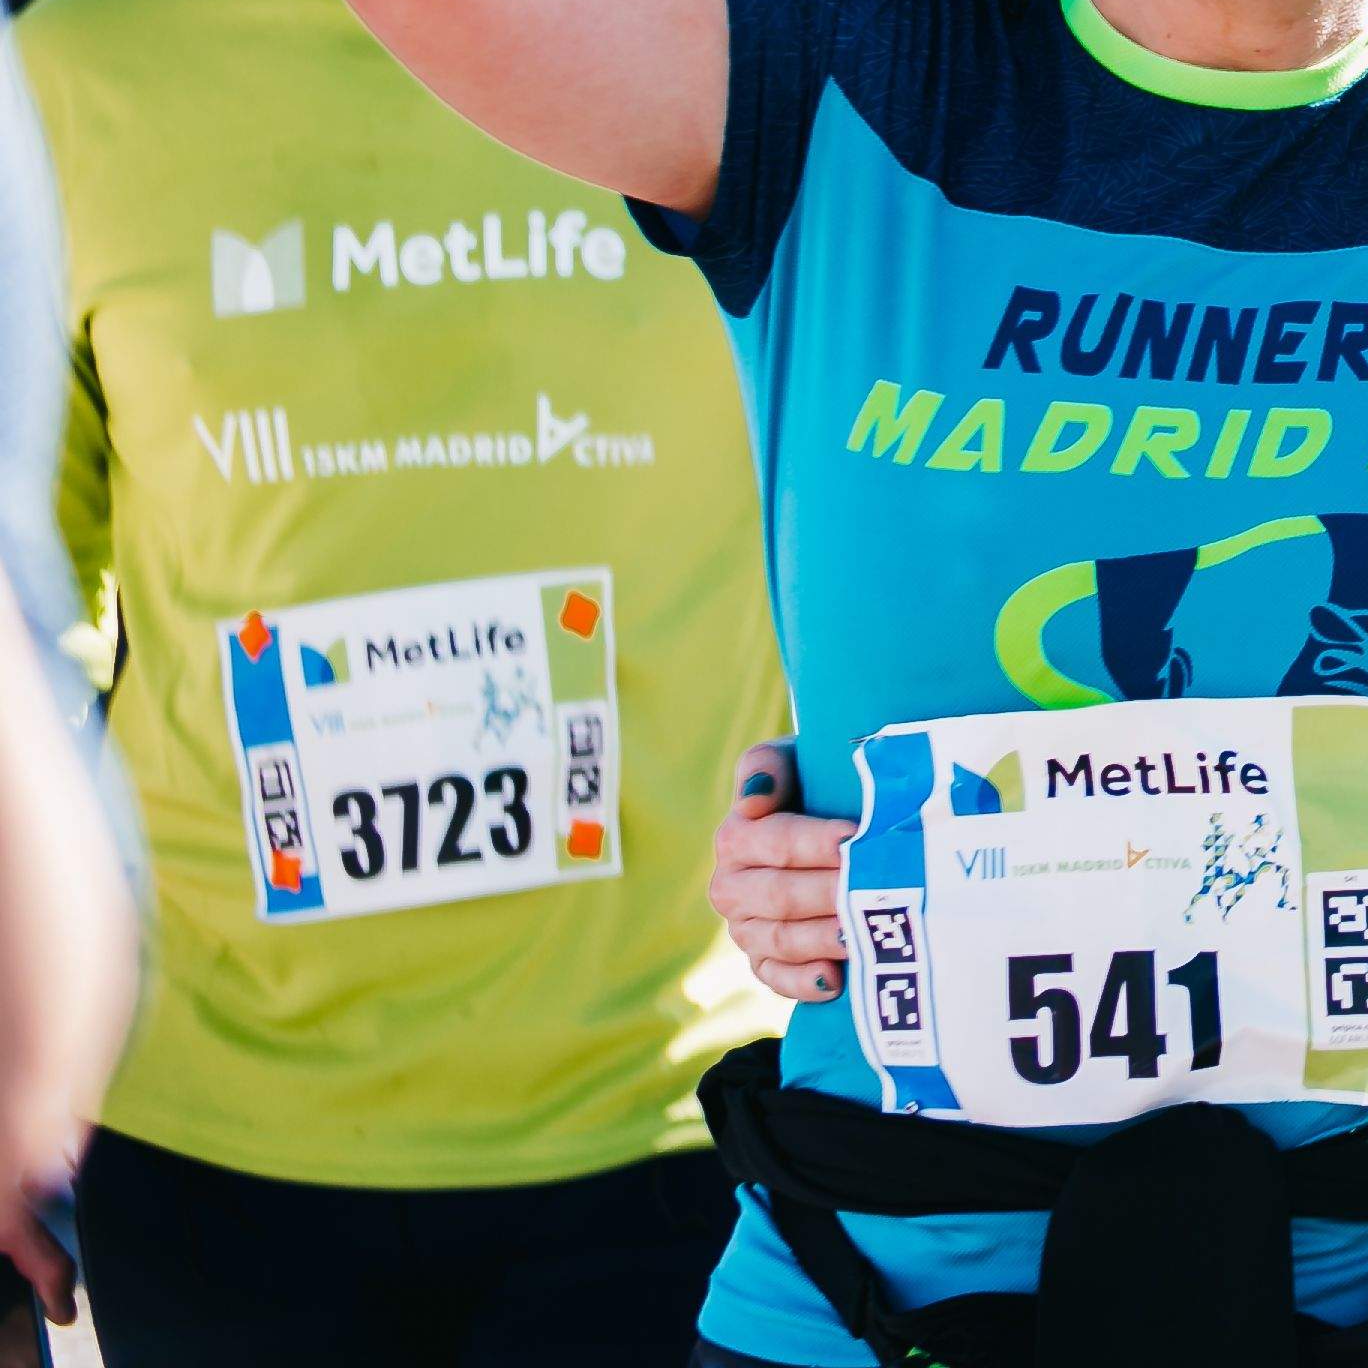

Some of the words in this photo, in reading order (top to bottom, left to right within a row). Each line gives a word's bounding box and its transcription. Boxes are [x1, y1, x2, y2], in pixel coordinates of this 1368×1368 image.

[332, 209, 626, 292] MetLife
[193, 405, 295, 485] VIII
[301, 438, 388, 479] 15KM
[394, 431, 533, 468] MADRID
[845, 379, 1333, 479] MADRID
[365, 620, 527, 675] MetLife
[1046, 749, 1270, 799] MetLife
[332, 767, 533, 880] 3723
[956, 847, 1006, 879] VIII
[1006, 948, 1222, 1085] 541
